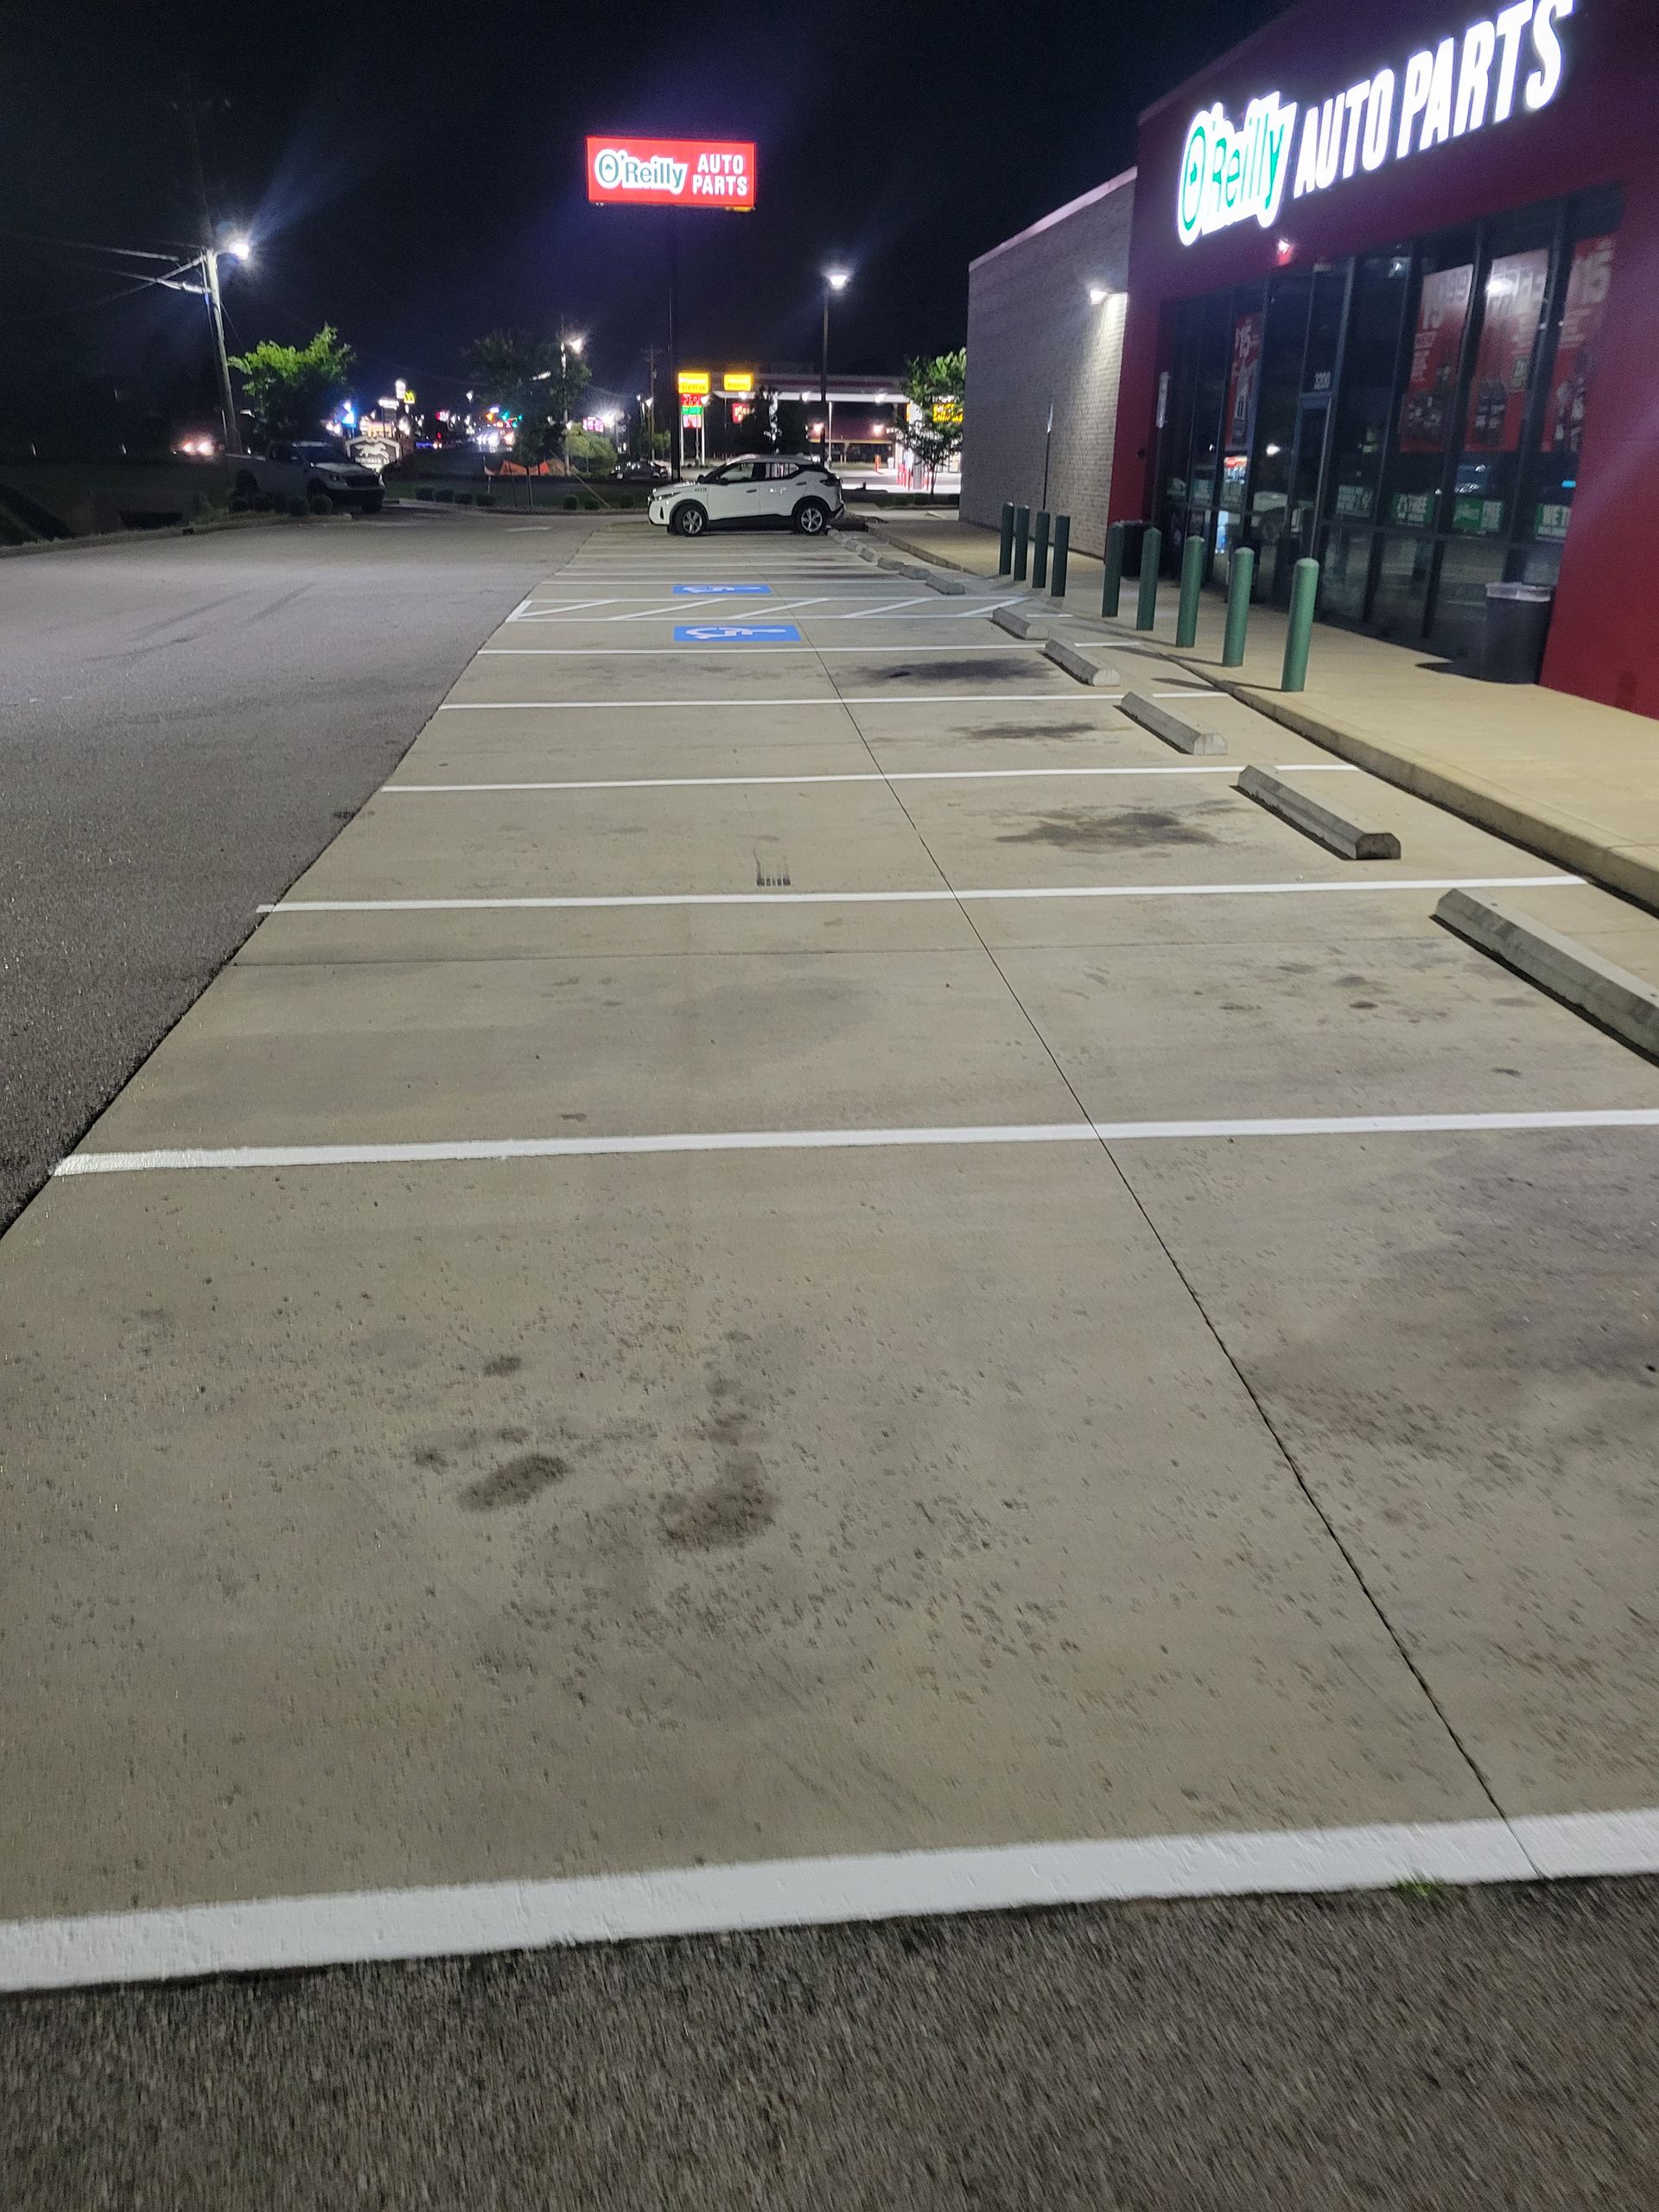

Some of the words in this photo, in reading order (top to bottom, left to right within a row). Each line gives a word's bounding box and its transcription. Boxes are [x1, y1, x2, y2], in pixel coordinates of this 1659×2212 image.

[1178, 92, 1294, 245] O'Reilly
[1294, 68, 1395, 199] AUTO
[1396, 0, 1573, 159] PARTS
[596, 150, 686, 192] O'Reilly
[696, 154, 744, 174] AUTO
[692, 175, 747, 196] PARTS
